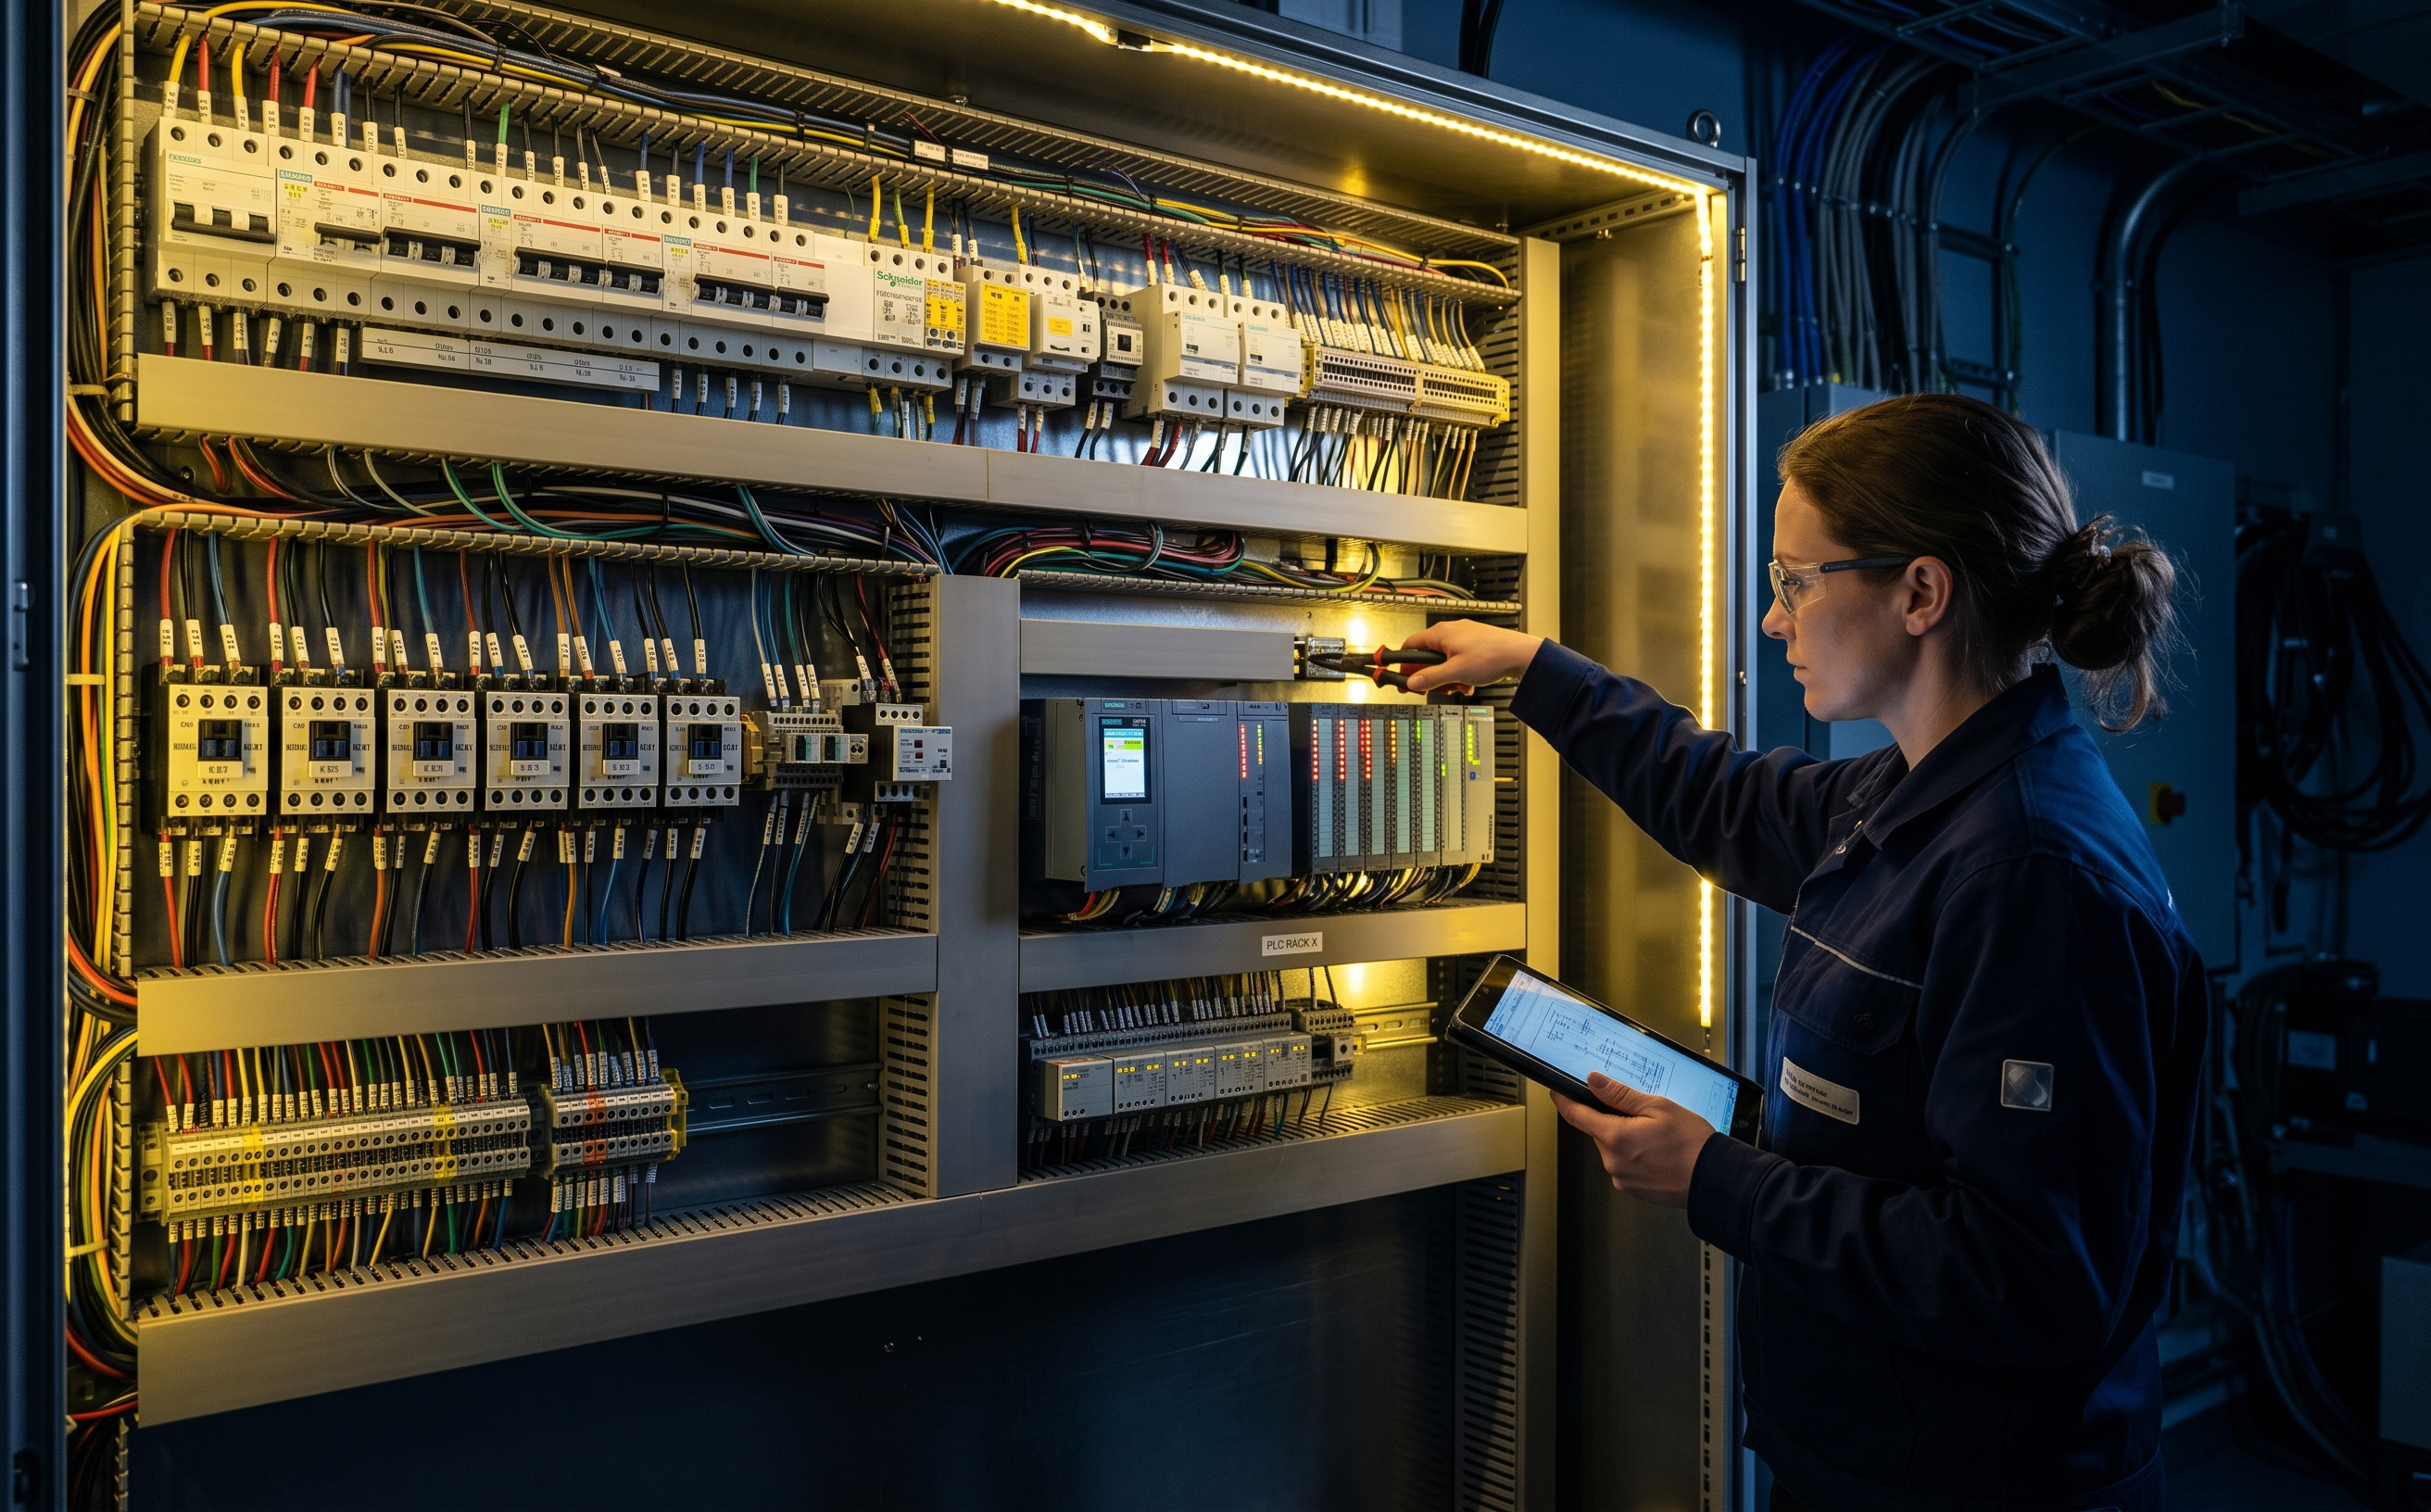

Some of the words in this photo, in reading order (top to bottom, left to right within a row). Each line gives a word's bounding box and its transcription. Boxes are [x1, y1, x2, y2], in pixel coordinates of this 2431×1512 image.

[1266, 939, 1284, 951] PLC
[1286, 938, 1310, 949] RACK
[1311, 937, 1318, 947] X
